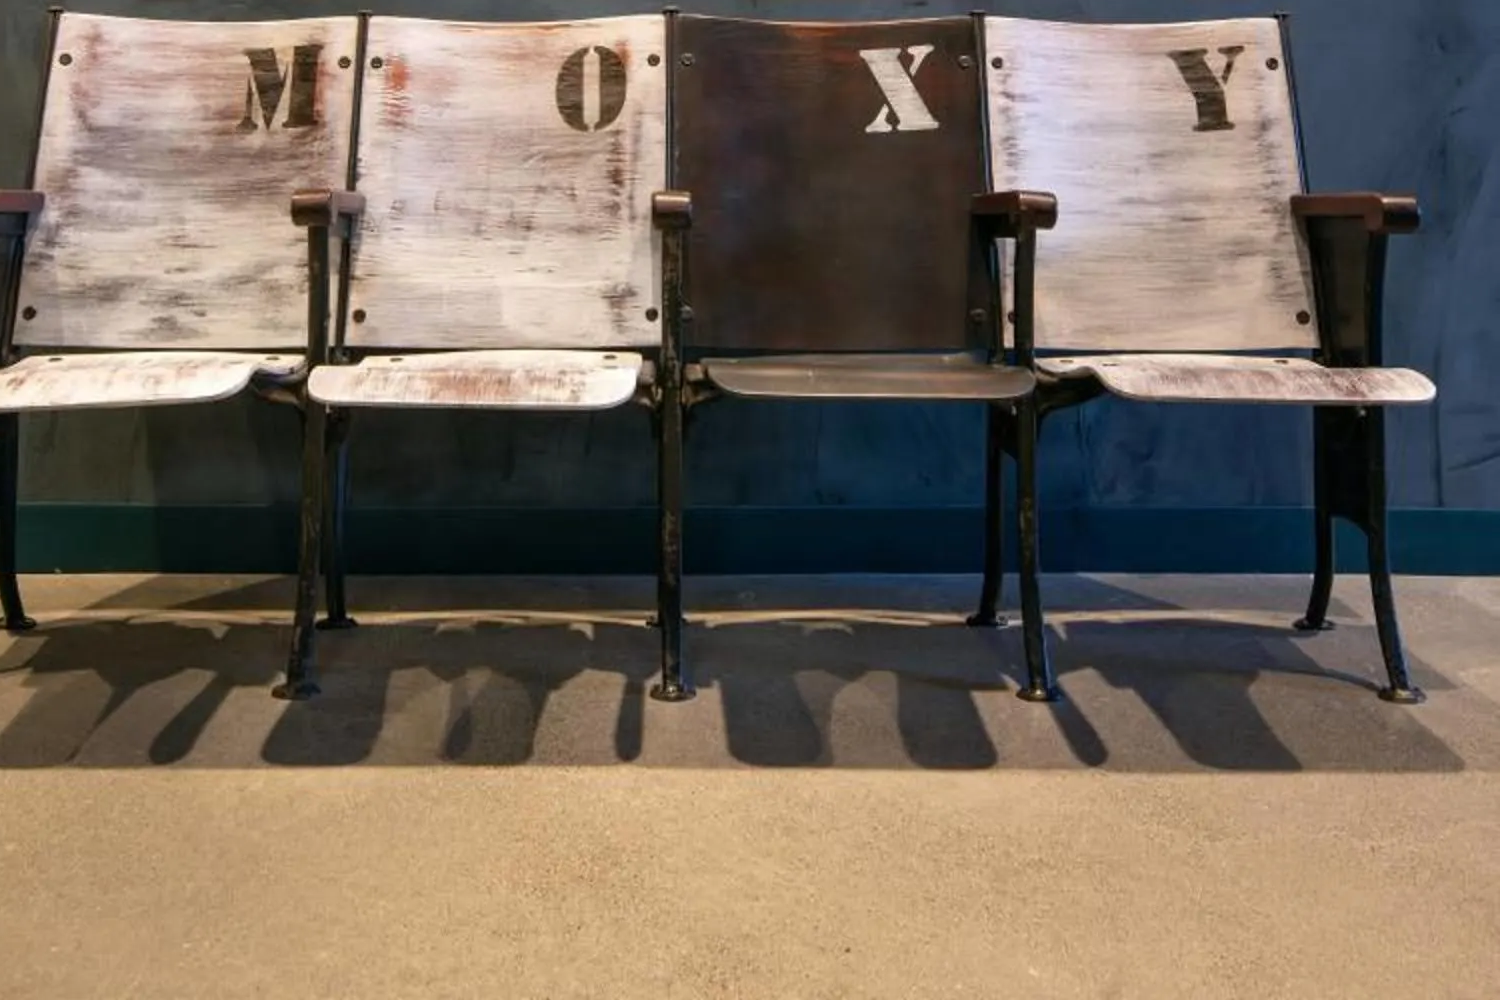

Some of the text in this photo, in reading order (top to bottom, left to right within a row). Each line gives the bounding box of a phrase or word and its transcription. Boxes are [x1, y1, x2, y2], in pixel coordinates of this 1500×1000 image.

[236, 43, 1248, 133] M O X Y
